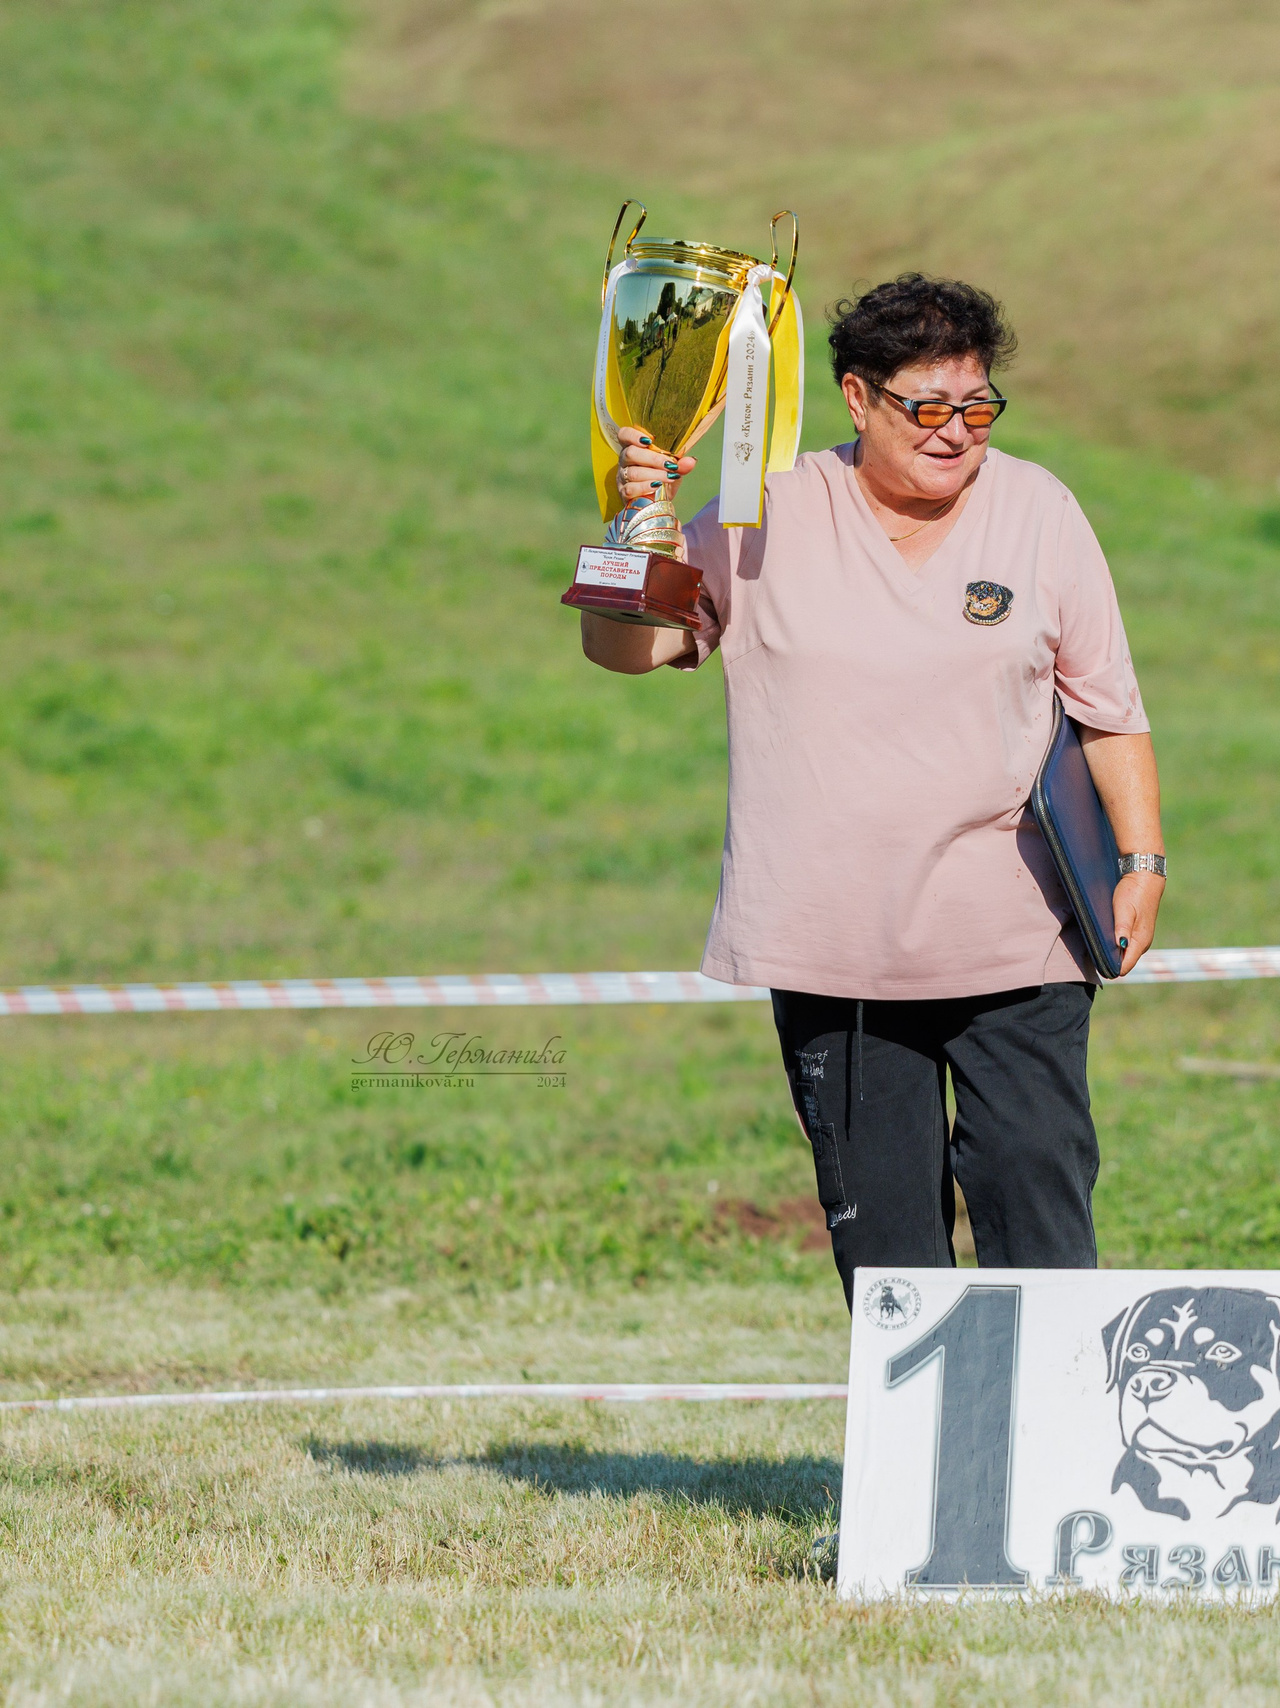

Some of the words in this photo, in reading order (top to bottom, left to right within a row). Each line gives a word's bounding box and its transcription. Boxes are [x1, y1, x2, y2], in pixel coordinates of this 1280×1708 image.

[743, 364, 754, 400] Рязани
[602, 560, 629, 568] ЛУЧШИЙ
[589, 564, 640, 575] ПРЕДСТАВИТЕЛЬ
[600, 572, 627, 580] ПОРОДЫ
[891, 1278, 912, 1288] КЛУБ
[886, 1284, 1029, 1588] 1
